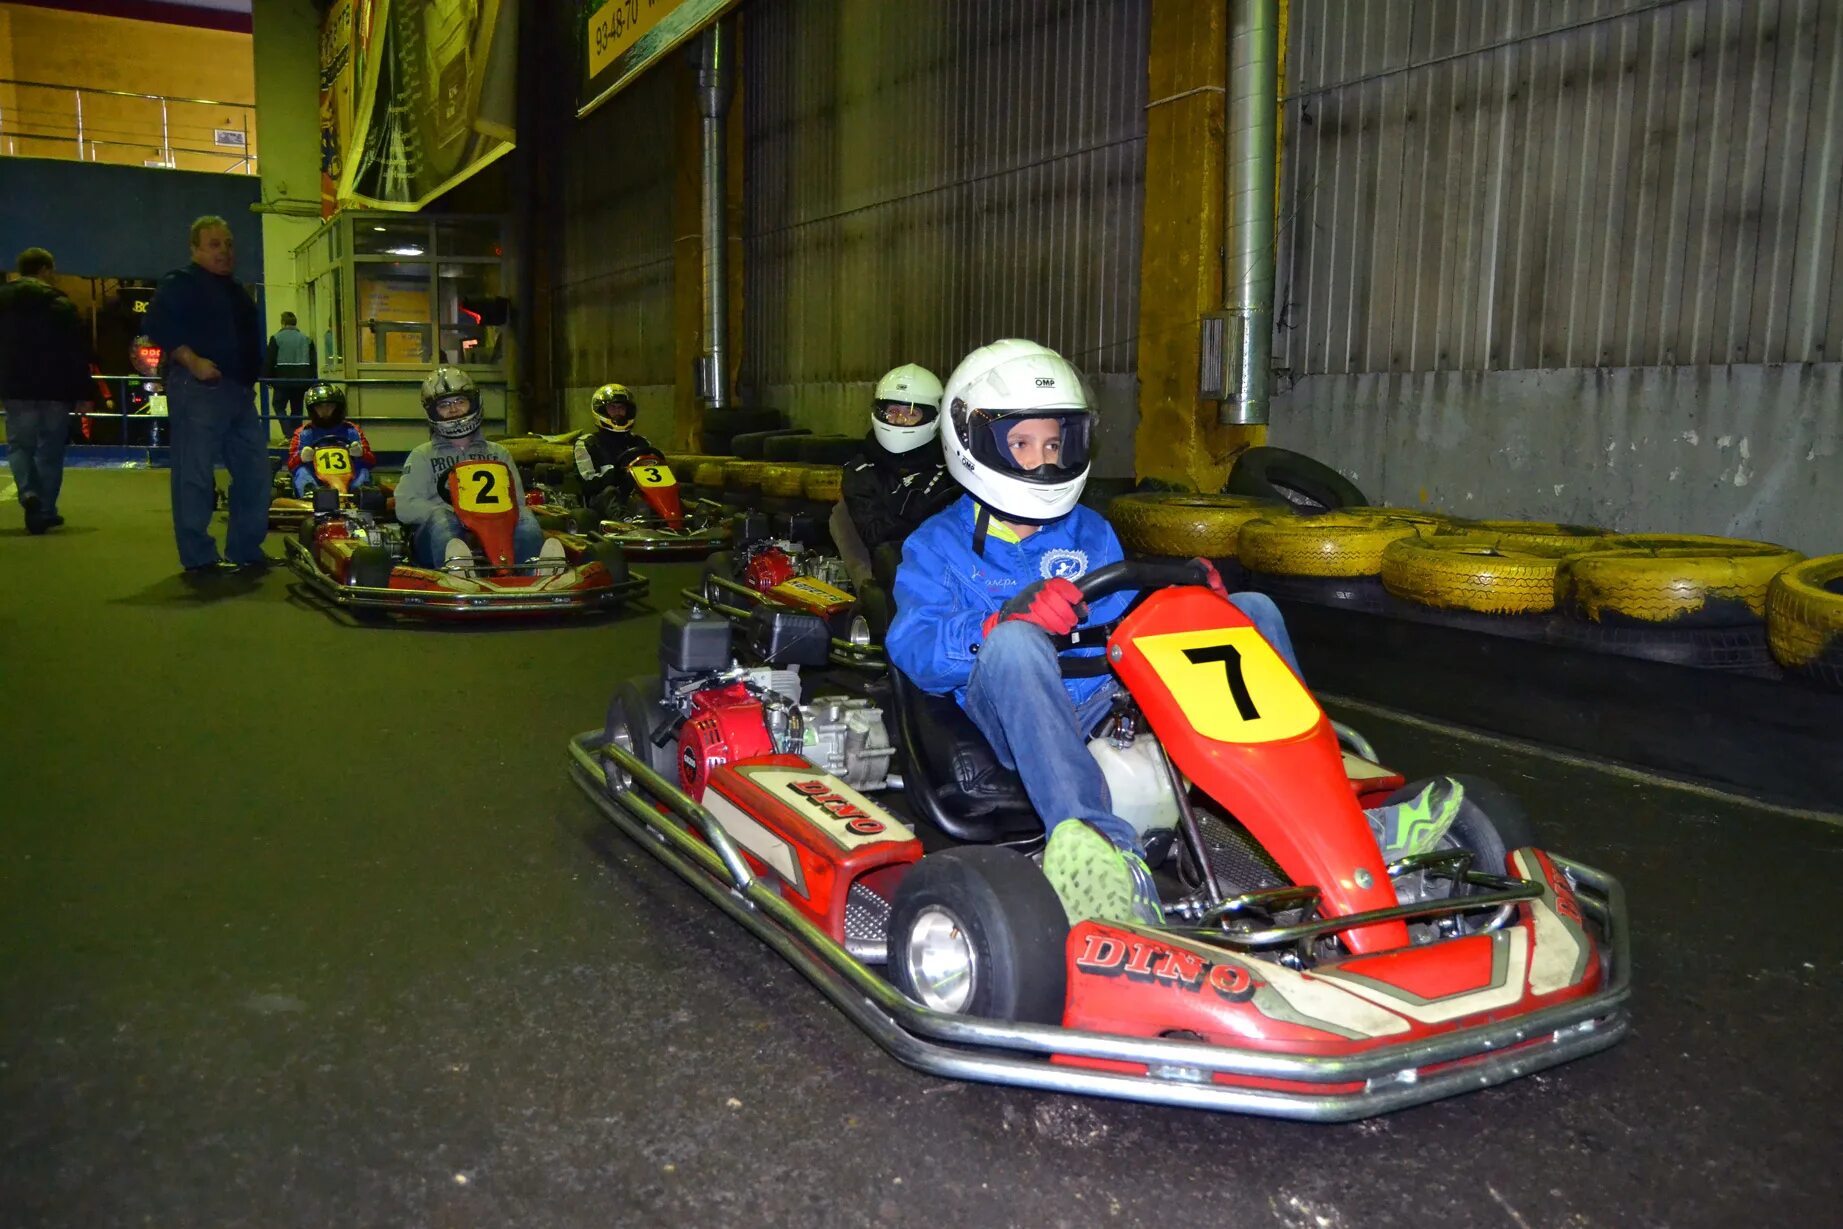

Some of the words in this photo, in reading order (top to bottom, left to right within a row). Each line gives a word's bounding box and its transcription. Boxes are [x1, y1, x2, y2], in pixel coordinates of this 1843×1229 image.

[1035, 379, 1055, 387] OMP
[319, 452, 347, 471] 13
[961, 457, 975, 471] OMP
[472, 470, 499, 504] 2
[644, 467, 662, 483] 3
[1181, 644, 1261, 722] 7
[786, 779, 887, 836] DINO
[1076, 934, 1257, 1003] DINO
